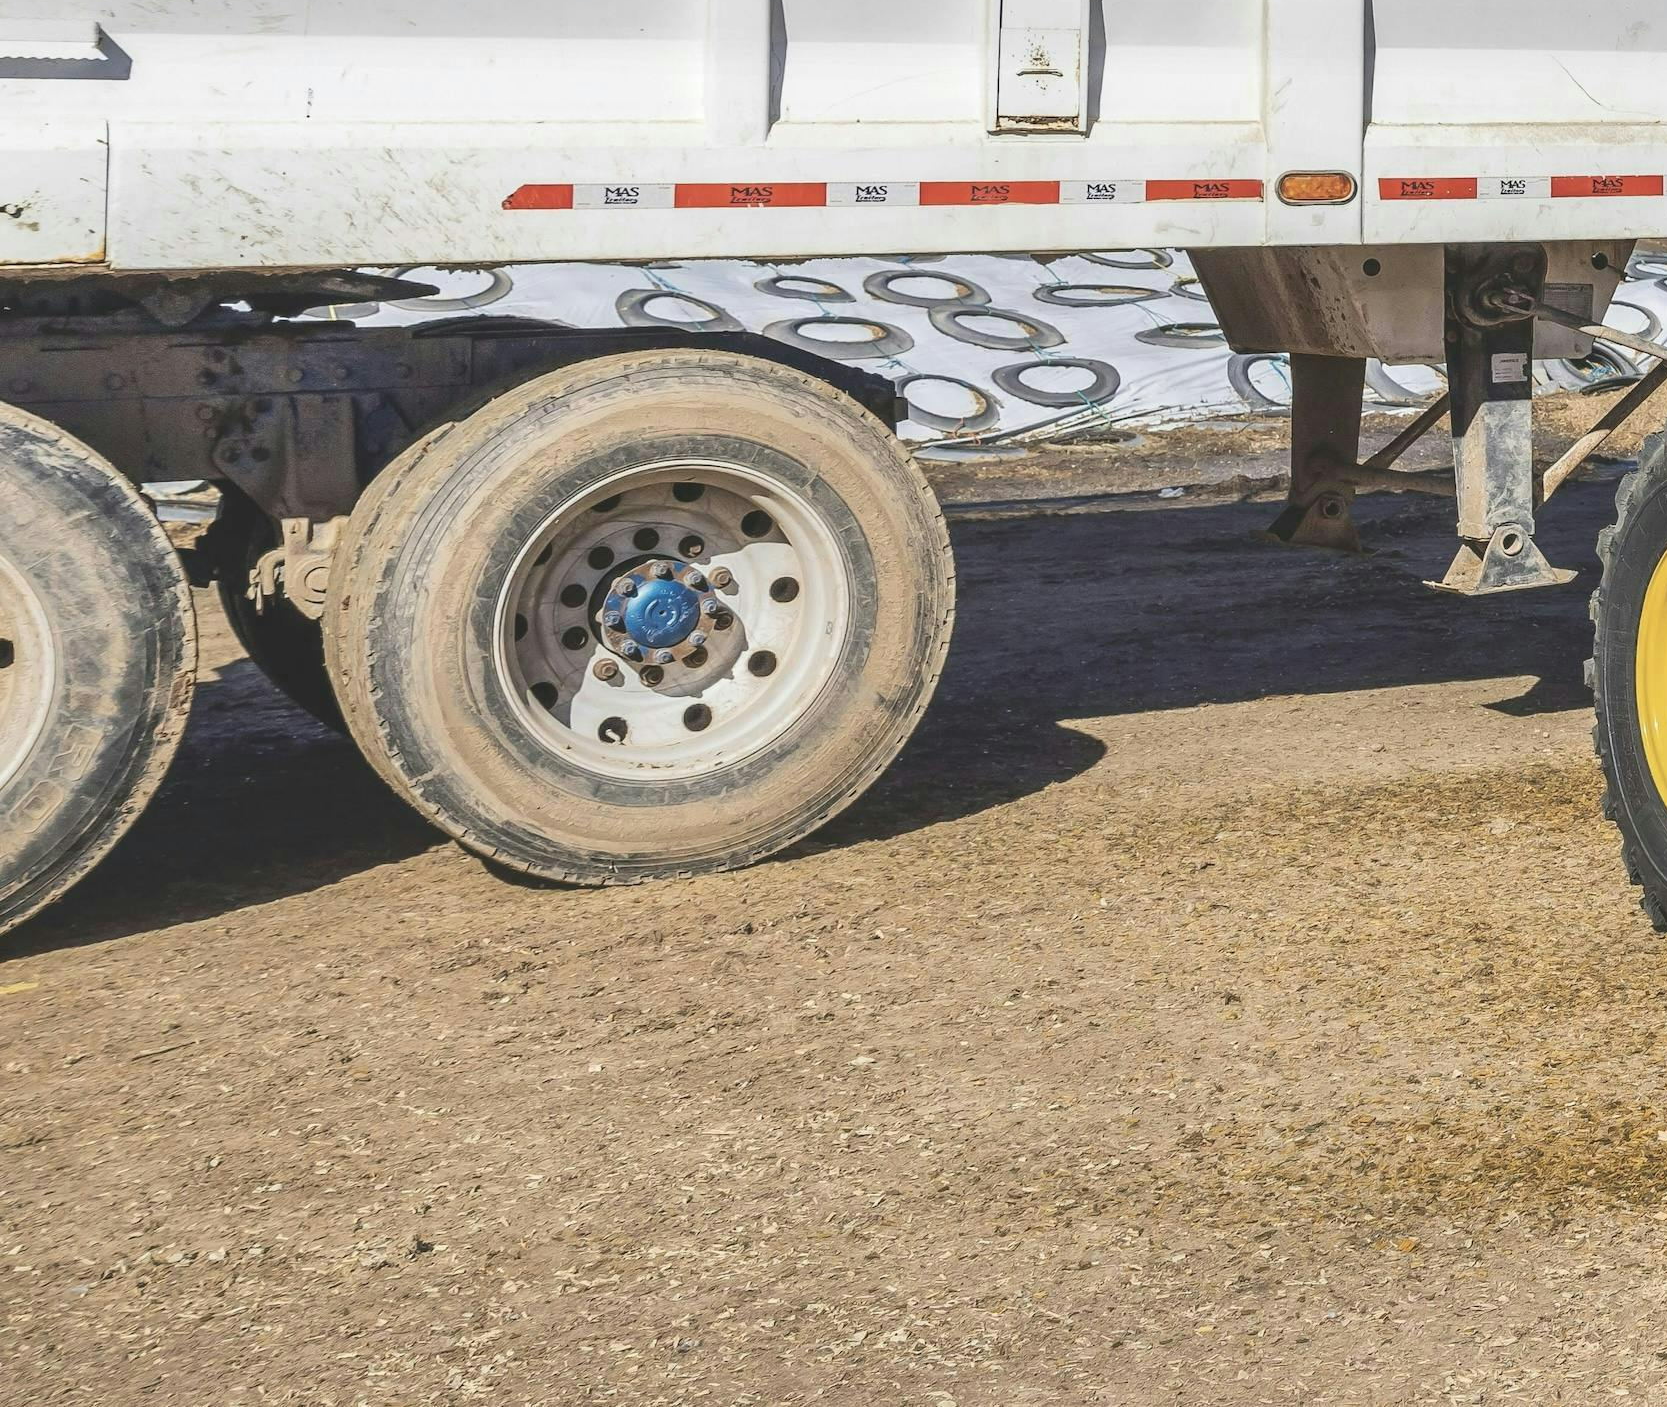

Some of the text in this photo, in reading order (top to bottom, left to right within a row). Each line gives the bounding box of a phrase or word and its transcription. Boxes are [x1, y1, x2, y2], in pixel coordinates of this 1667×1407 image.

[1401, 181, 1434, 190] MAS
[1500, 180, 1526, 188] MAS
[1592, 178, 1623, 187] MAS
[604, 187, 639, 197] MAS
[730, 187, 773, 196] MAS
[855, 186, 887, 195] MAS
[971, 185, 1010, 194] MAS
[1087, 184, 1116, 193] MAS
[1193, 183, 1229, 192] MAS
